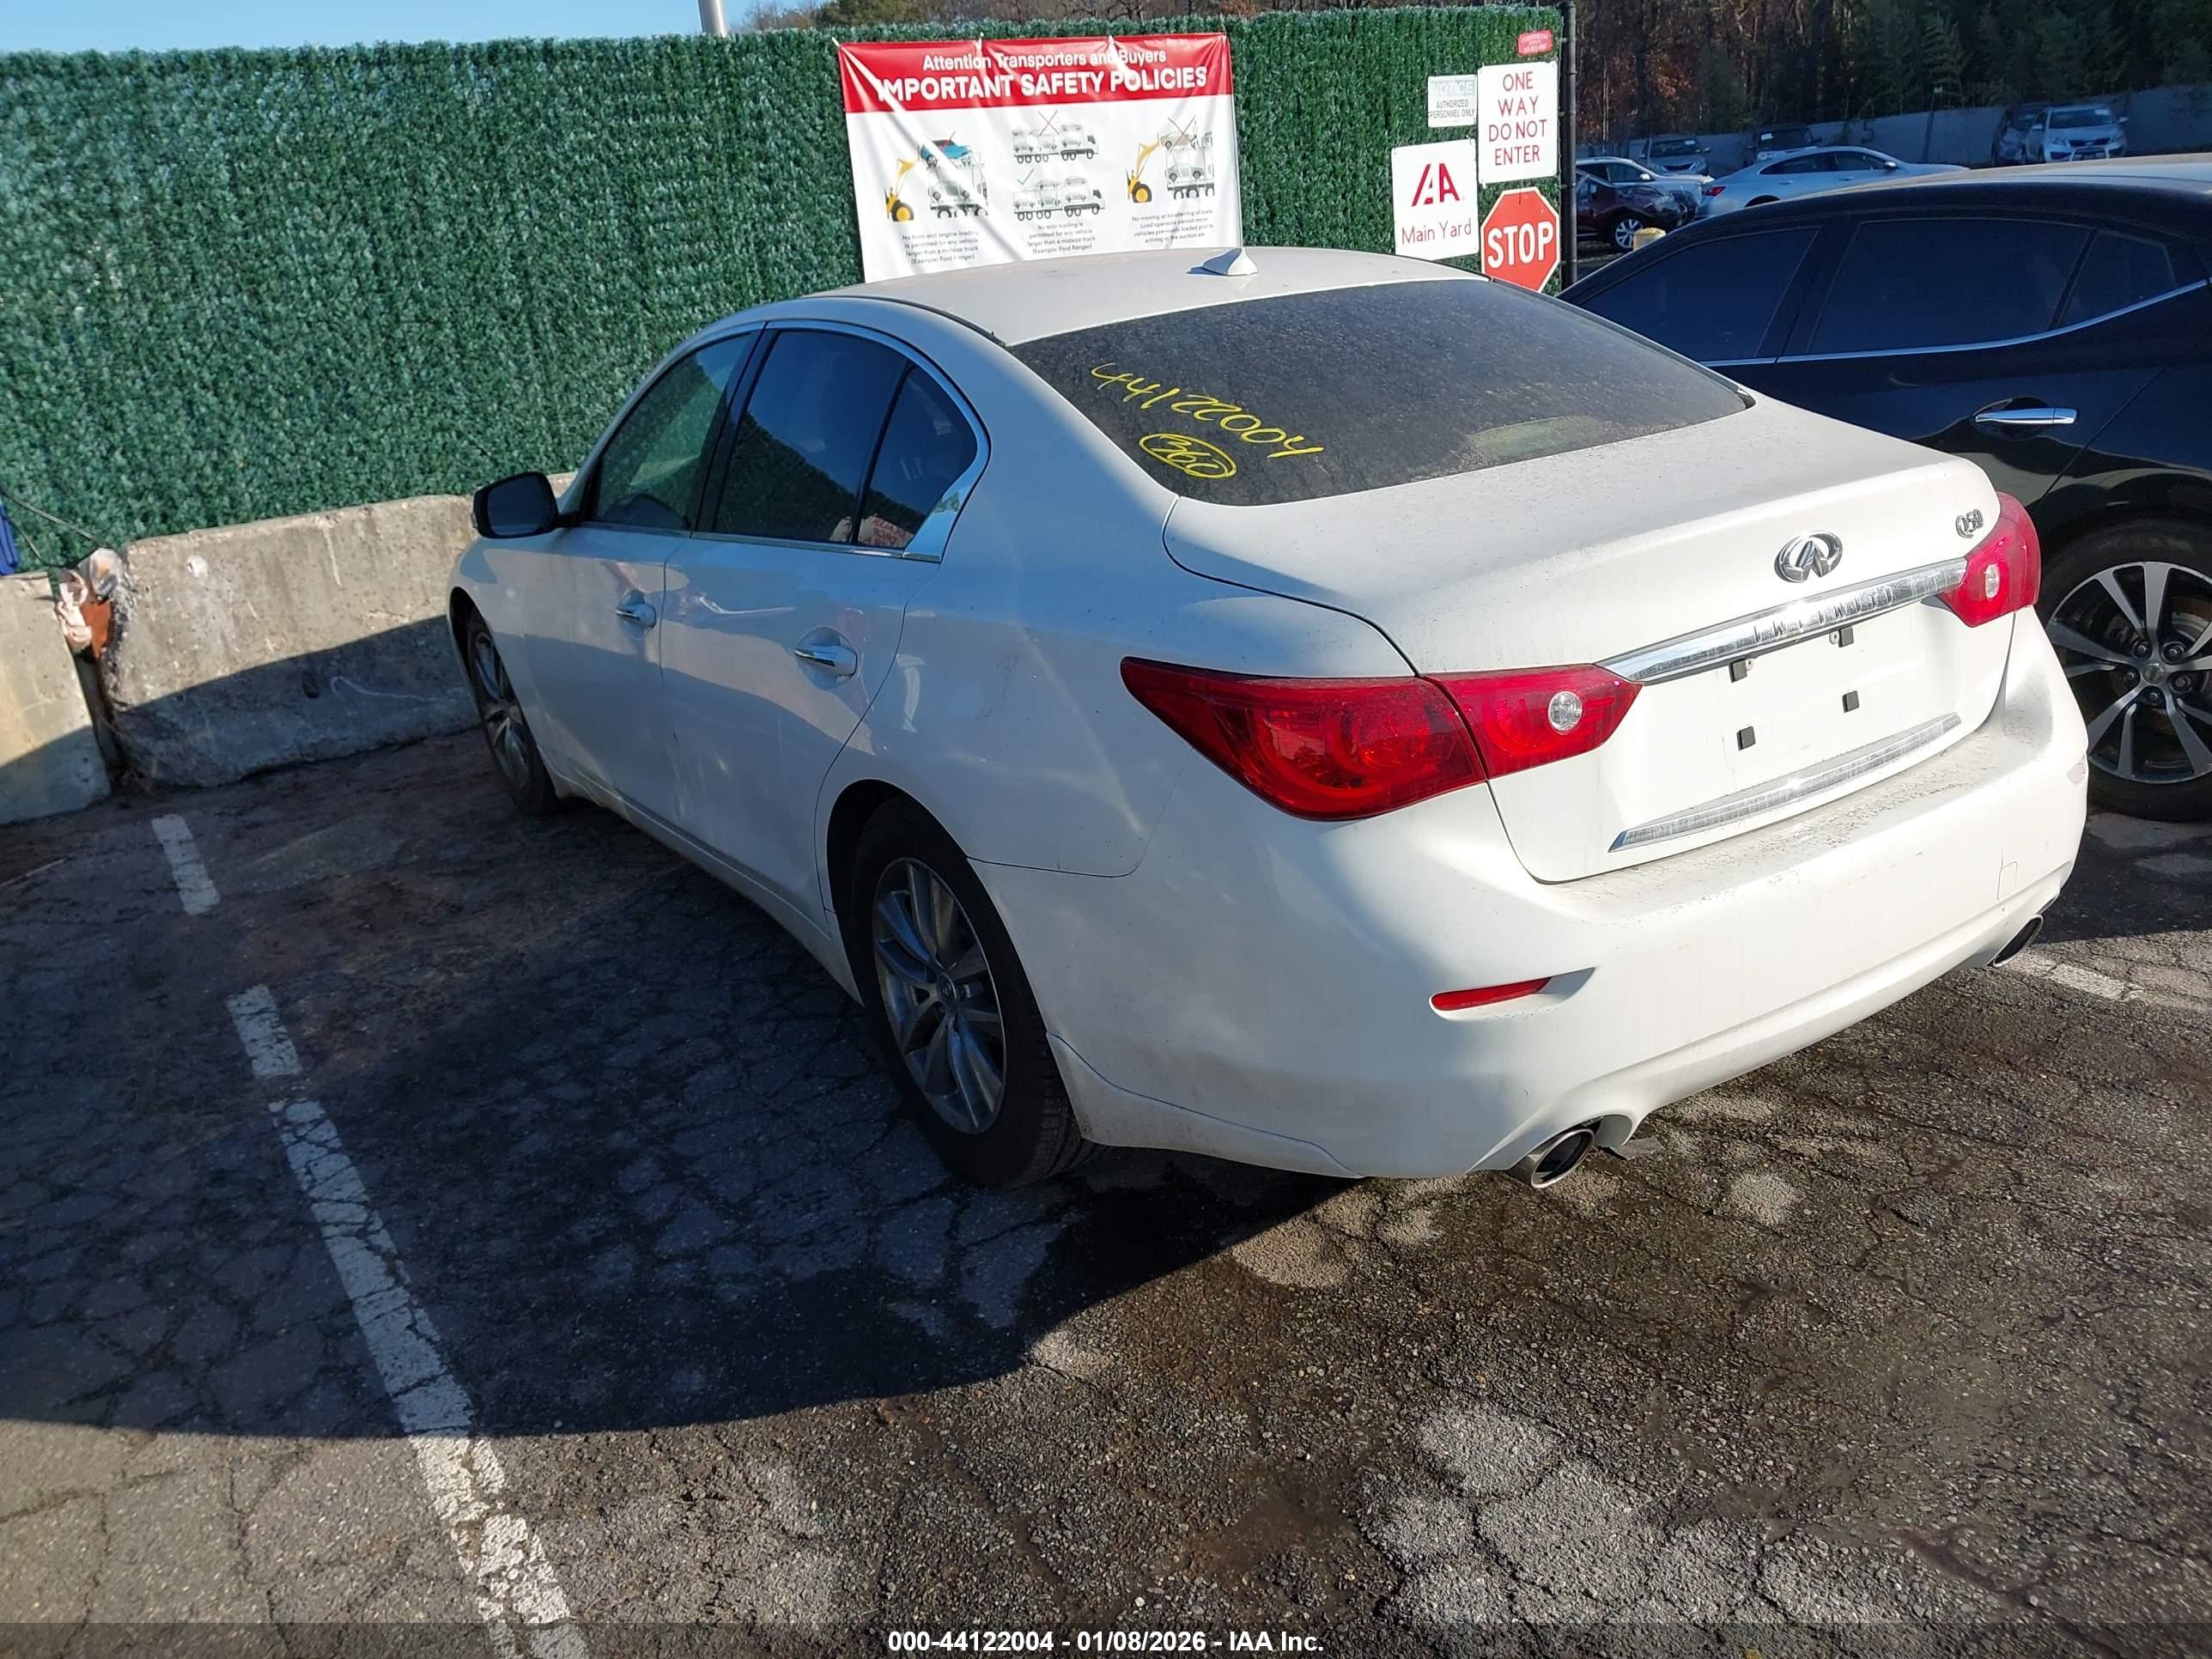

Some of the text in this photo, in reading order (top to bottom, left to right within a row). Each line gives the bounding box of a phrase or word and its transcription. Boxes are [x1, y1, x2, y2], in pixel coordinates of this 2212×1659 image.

[923, 49, 1166, 70] Attention Transporters and Buyers
[878, 66, 1207, 101] IMPORTANT SAFETY POLICIES
[1503, 70, 1534, 92] ONE
[1429, 108, 1475, 118] PERSONNEL ONLY
[1436, 99, 1469, 109] AUTHORIZED
[1498, 96, 1539, 117] WAY
[1488, 119, 1547, 143] DO NOT
[1495, 144, 1540, 166] ENTER
[1401, 218, 1472, 245] Main Yard
[1487, 221, 1554, 269] STOP
[1091, 363, 1324, 459] 44122004
[1146, 433, 1232, 477] 360
[1955, 508, 1984, 539] Q50
